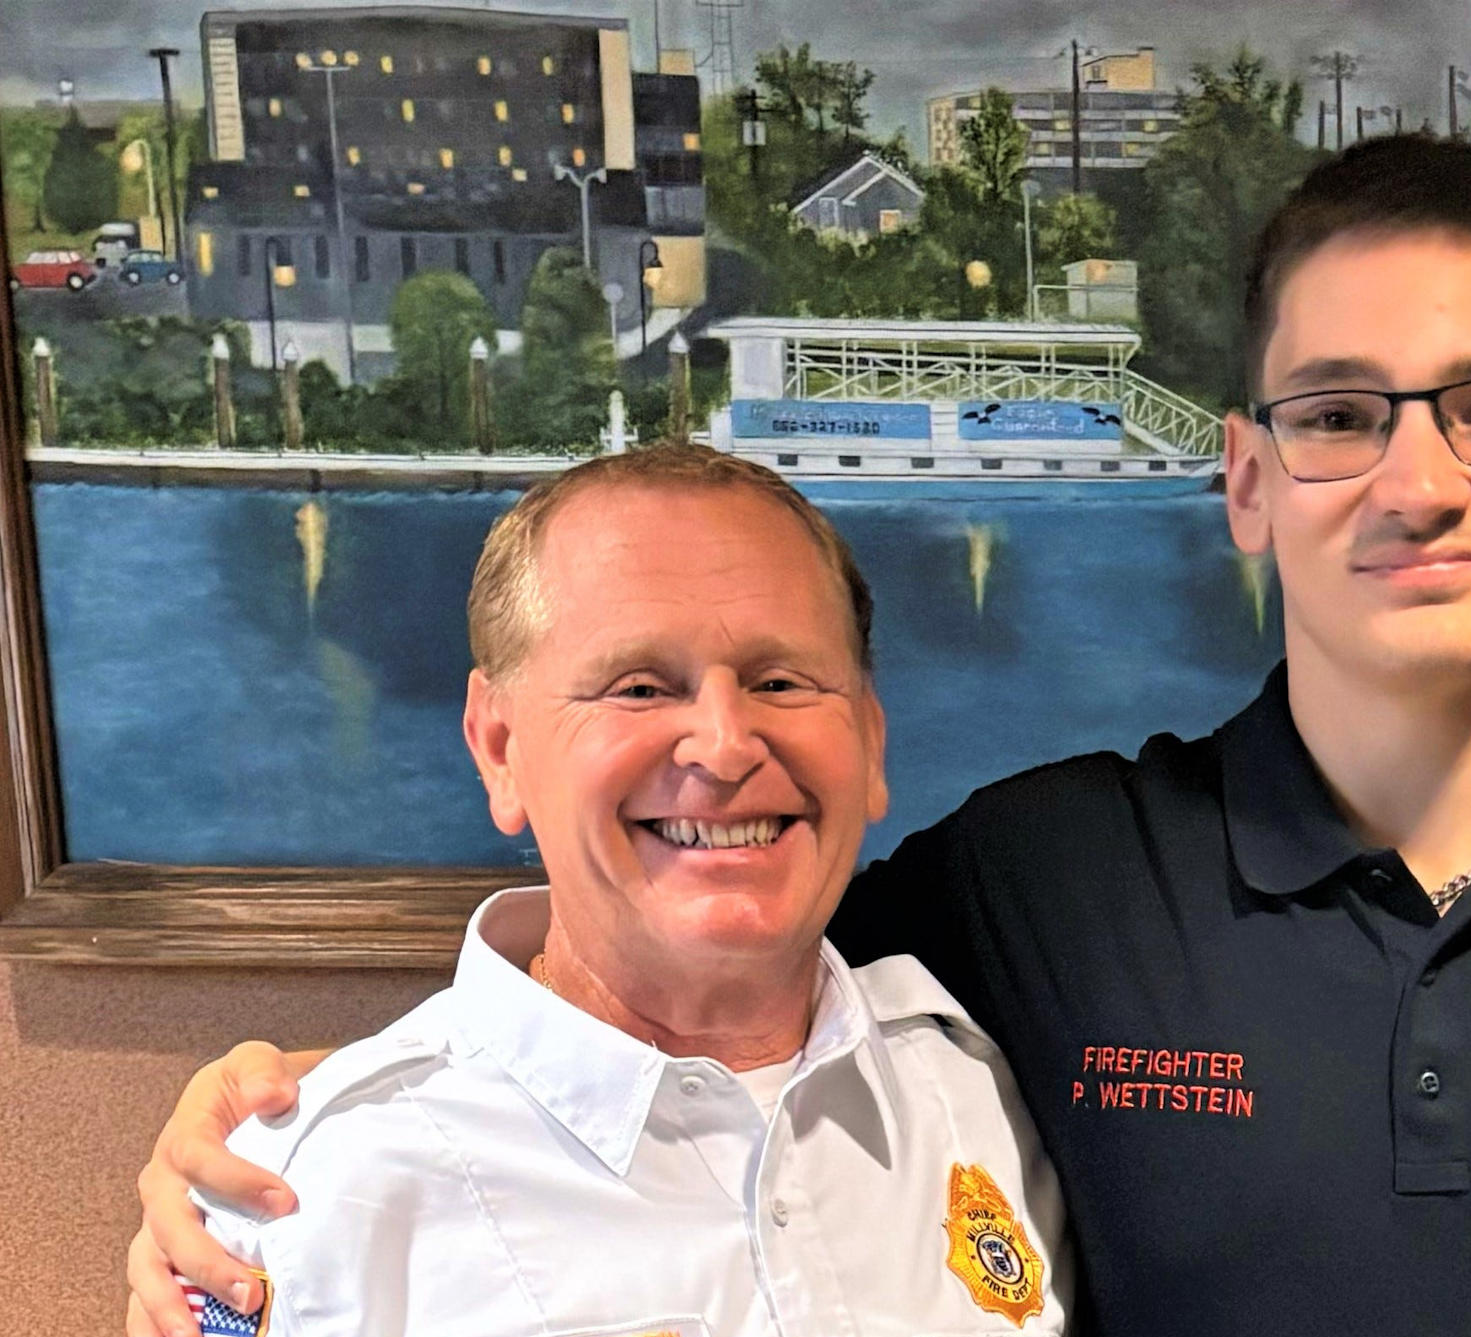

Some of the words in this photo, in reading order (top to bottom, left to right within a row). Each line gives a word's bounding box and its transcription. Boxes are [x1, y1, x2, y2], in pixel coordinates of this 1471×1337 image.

[1083, 1046, 1244, 1080] FIREFIGHTER
[1099, 1081, 1253, 1117] WETTSTEIN
[967, 1208, 997, 1221] CHIEF
[966, 1222, 1015, 1243] MILLVILLE
[982, 1275, 1008, 1298] FIRE
